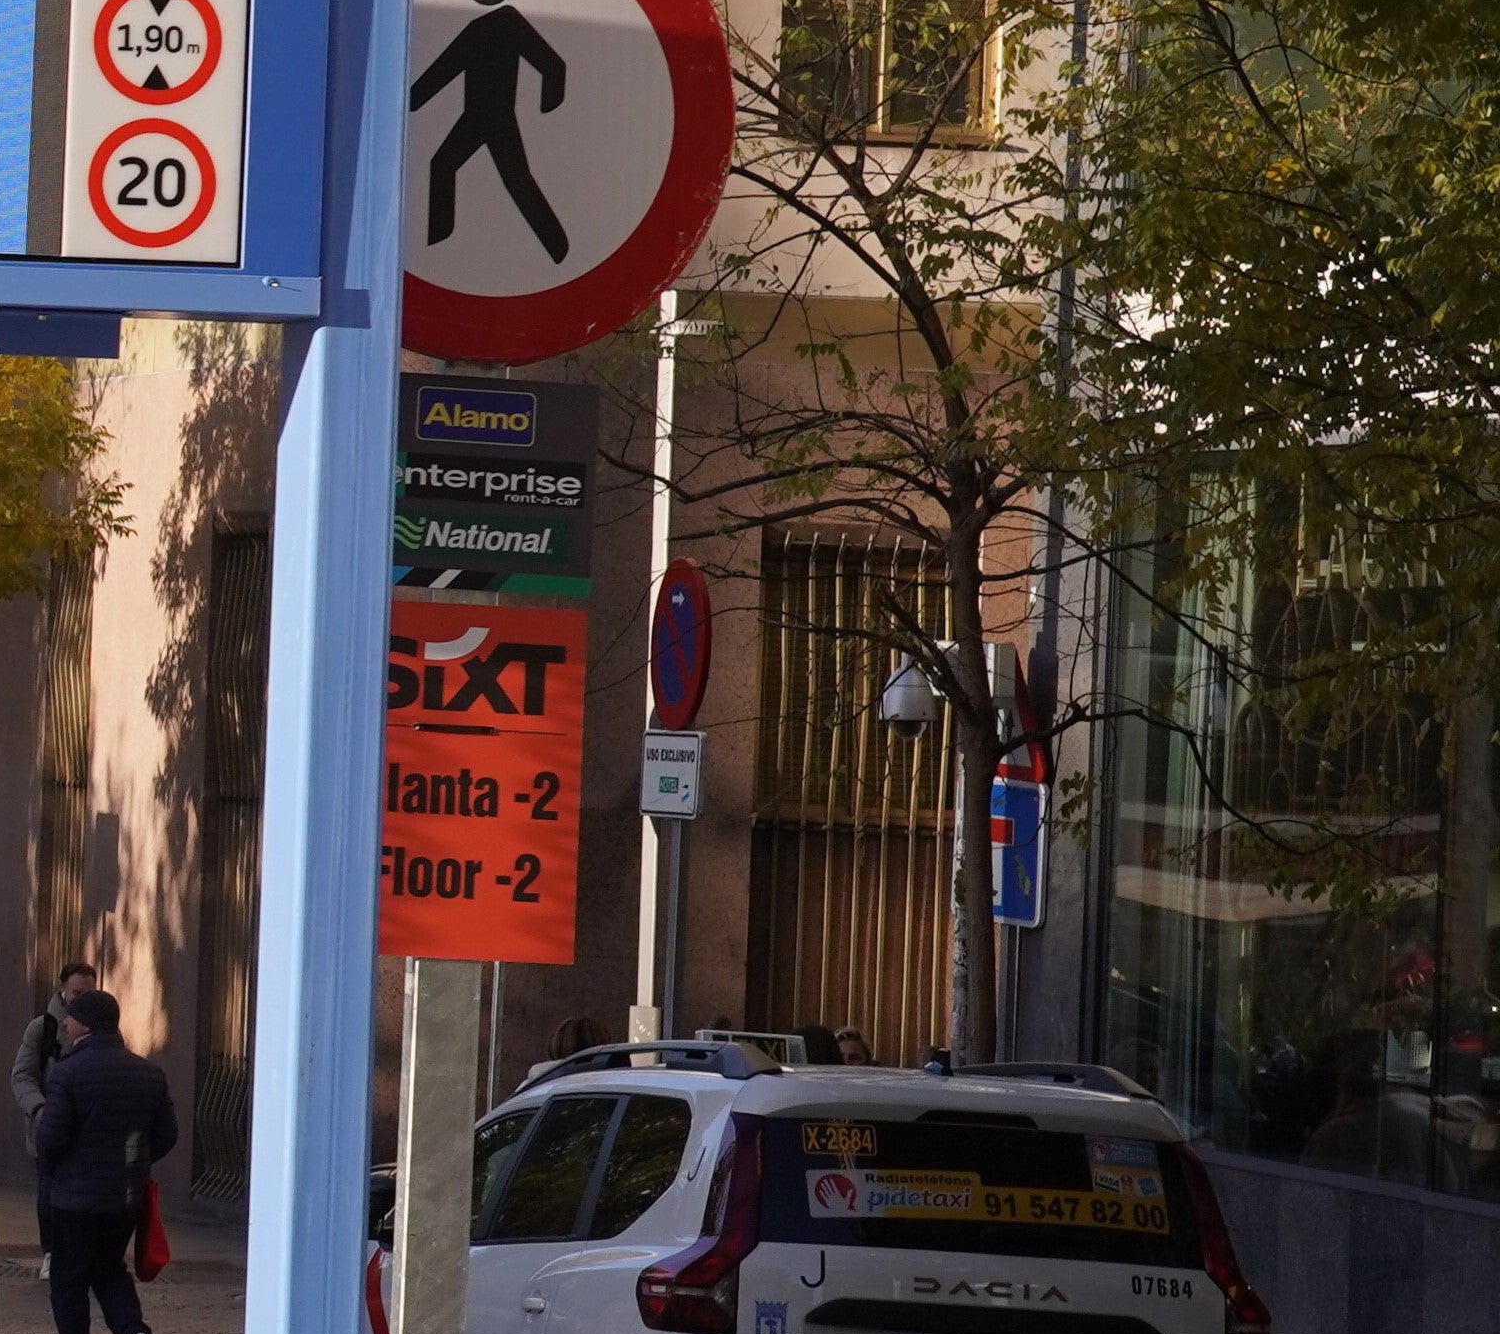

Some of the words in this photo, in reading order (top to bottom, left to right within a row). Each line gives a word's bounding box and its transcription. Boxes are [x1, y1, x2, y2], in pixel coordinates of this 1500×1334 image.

[117, 156, 187, 208] 20
[423, 402, 530, 432] Alamo
[503, 492, 581, 507] rent-a-car
[424, 520, 552, 554] National
[646, 748, 659, 761] USO
[661, 749, 695, 763] EXCLUSIVO
[387, 763, 498, 818] lanta
[514, 771, 559, 821] -2
[495, 853, 540, 902] -2
[805, 1125, 874, 1153] X-2684
[865, 1173, 972, 1187] Radioteléfono
[866, 1187, 972, 1212] pidetaxi
[985, 1192, 1017, 1219] 91
[1031, 1196, 1080, 1222] 547
[1091, 1201, 1125, 1227] 82
[1133, 1204, 1167, 1230] 00
[801, 1251, 826, 1289] J
[914, 1277, 1069, 1303] DACIA
[1131, 1275, 1193, 1300] 07684
